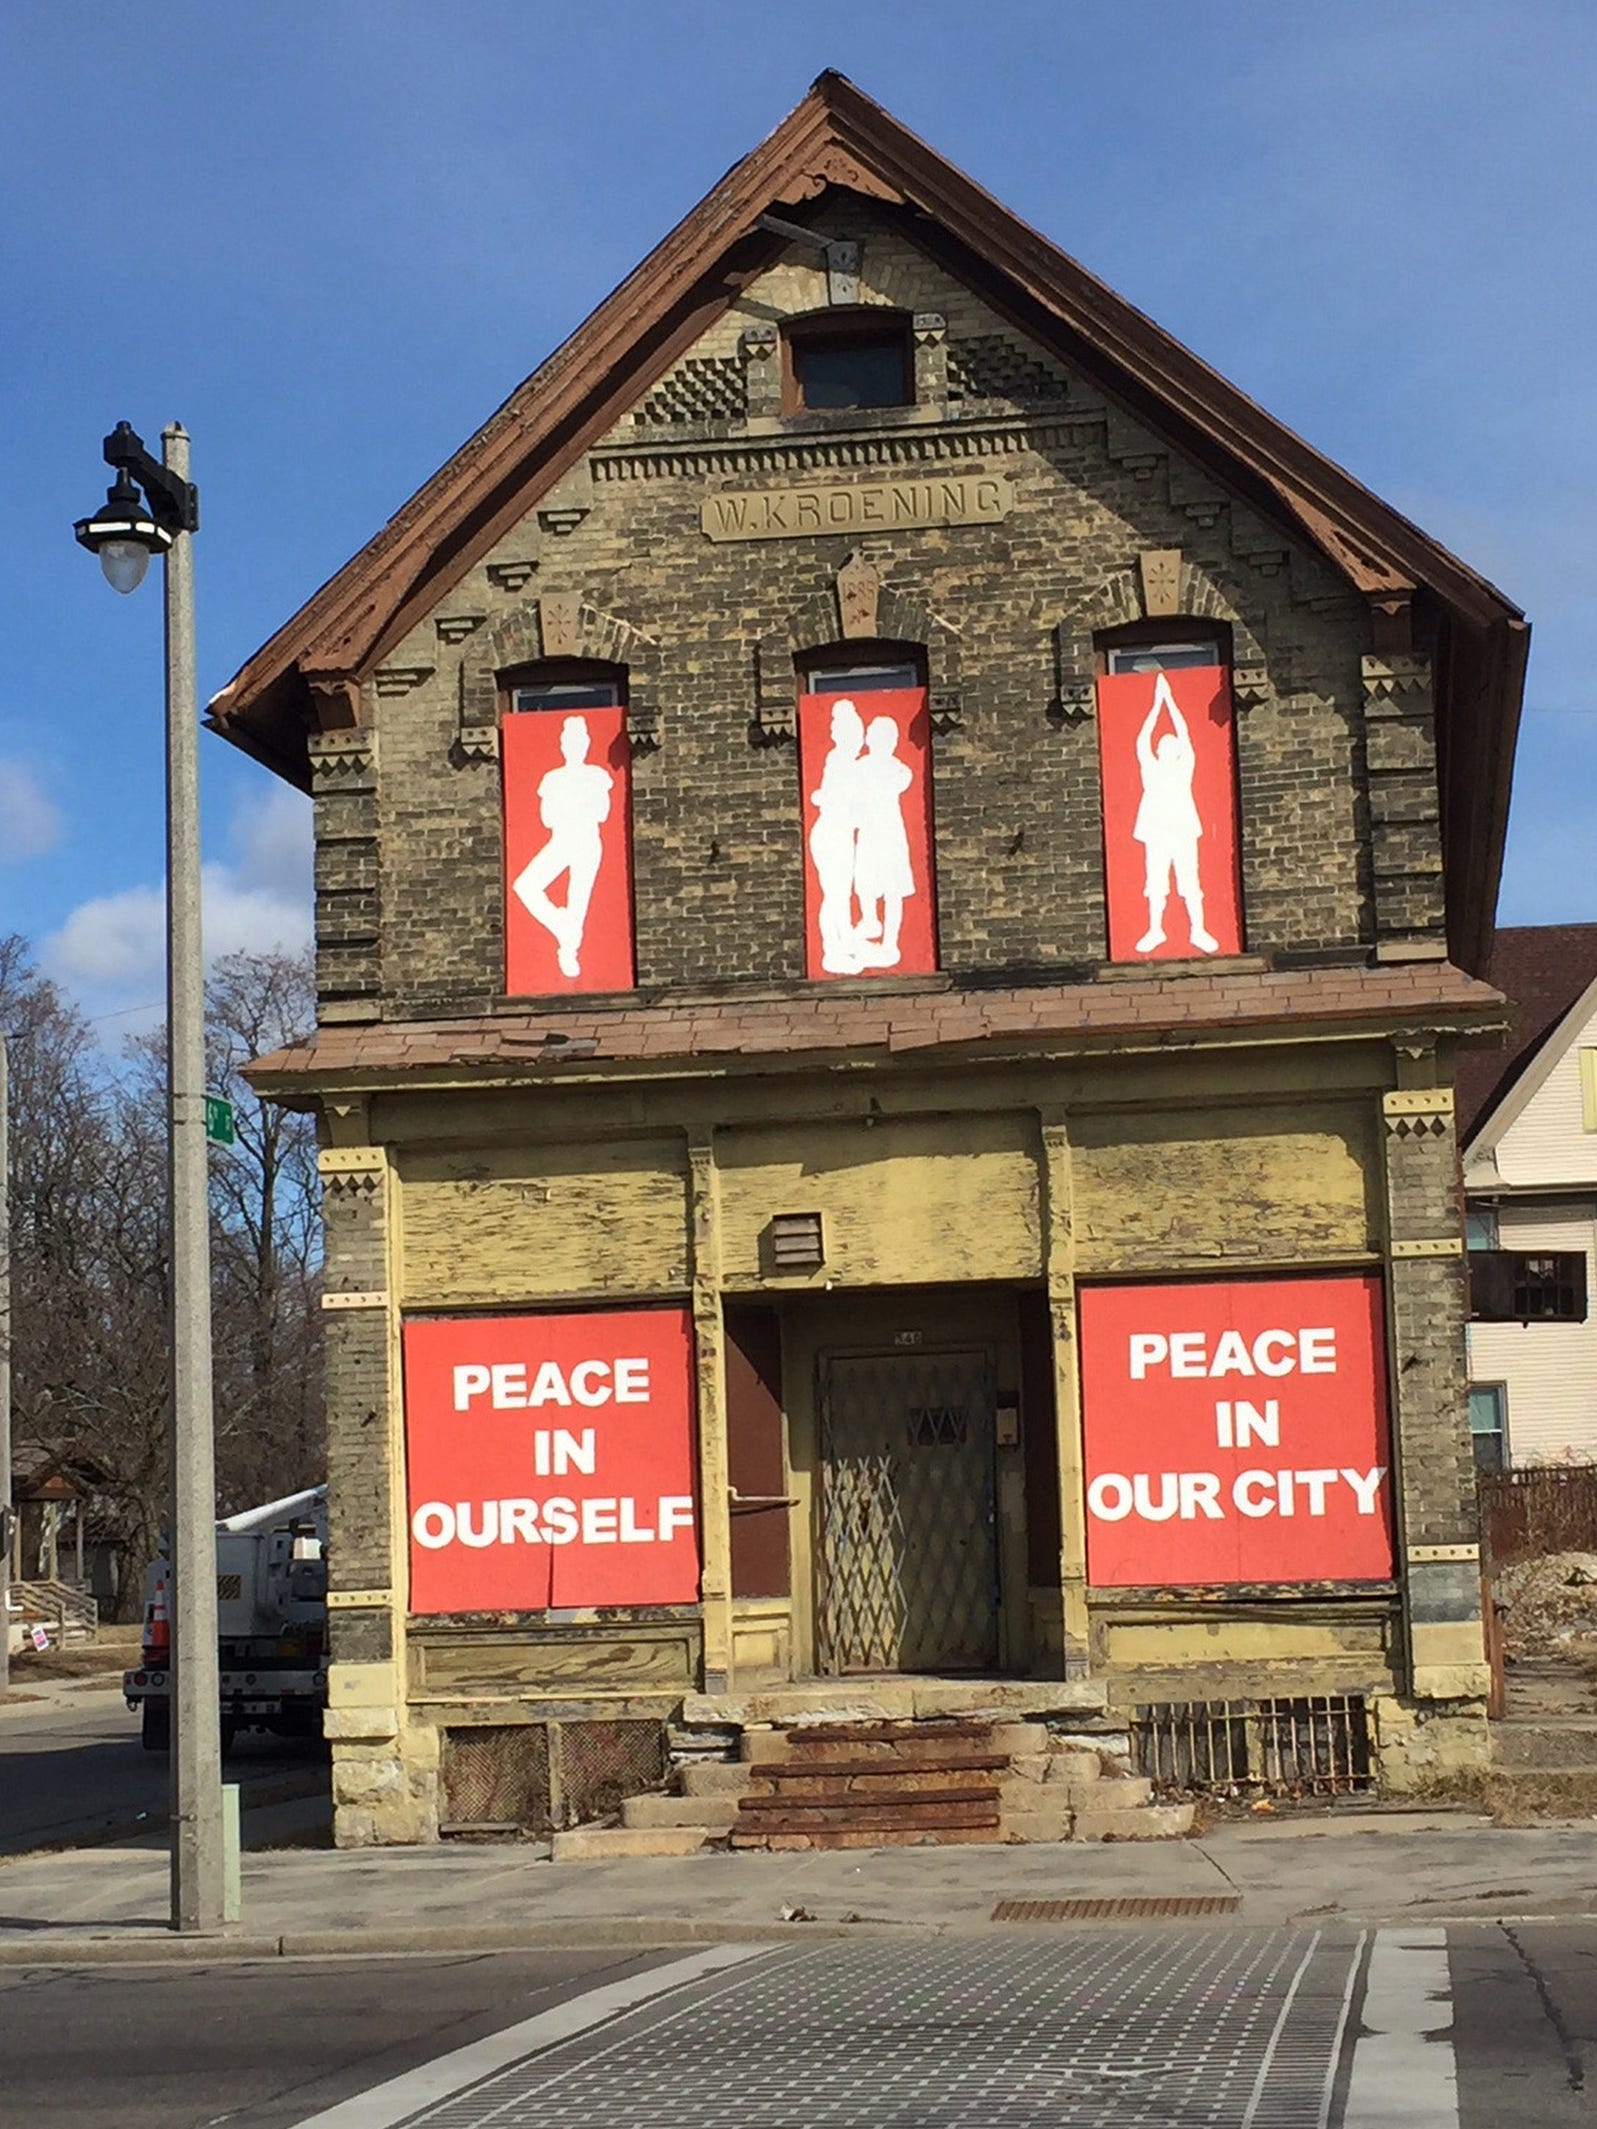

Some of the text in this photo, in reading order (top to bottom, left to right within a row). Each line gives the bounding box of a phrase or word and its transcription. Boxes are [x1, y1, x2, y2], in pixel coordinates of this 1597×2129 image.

[1129, 1327, 1337, 1380] PEACE
[453, 1358, 650, 1411] PEACE
[1215, 1399, 1280, 1448] IN
[534, 1428, 595, 1476] IN
[1087, 1467, 1387, 1521] OUR CITY
[412, 1496, 694, 1549] OURSELF
